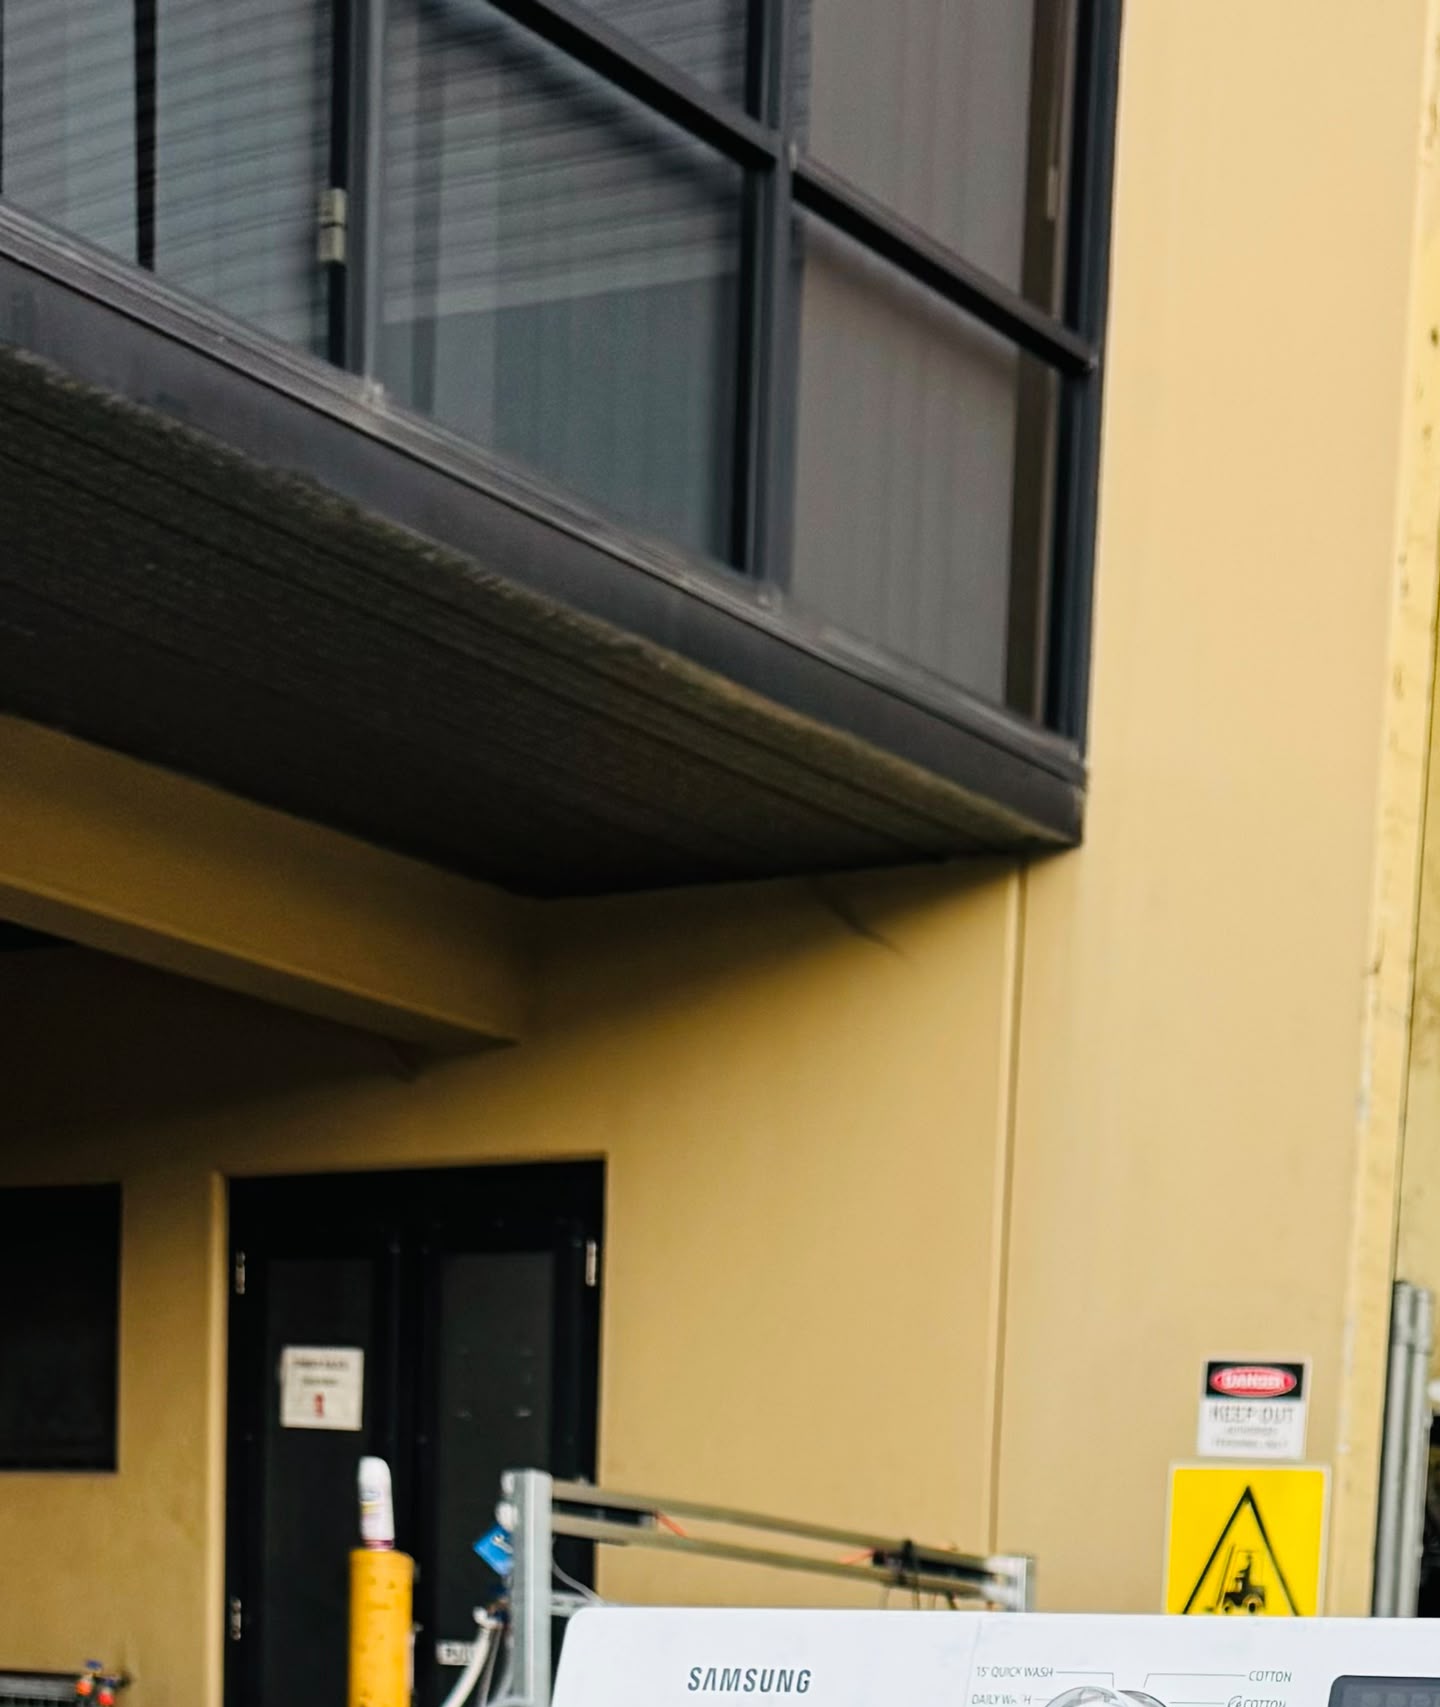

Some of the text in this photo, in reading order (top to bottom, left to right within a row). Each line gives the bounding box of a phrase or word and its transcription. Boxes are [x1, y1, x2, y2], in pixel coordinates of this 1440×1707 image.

[991, 1666, 1022, 1678] QUICK
[1024, 1666, 1053, 1678] WASH
[1248, 1670, 1292, 1682] COTTON
[687, 1666, 812, 1693] SAMSUNG
[971, 1694, 1000, 1705] DAILY
